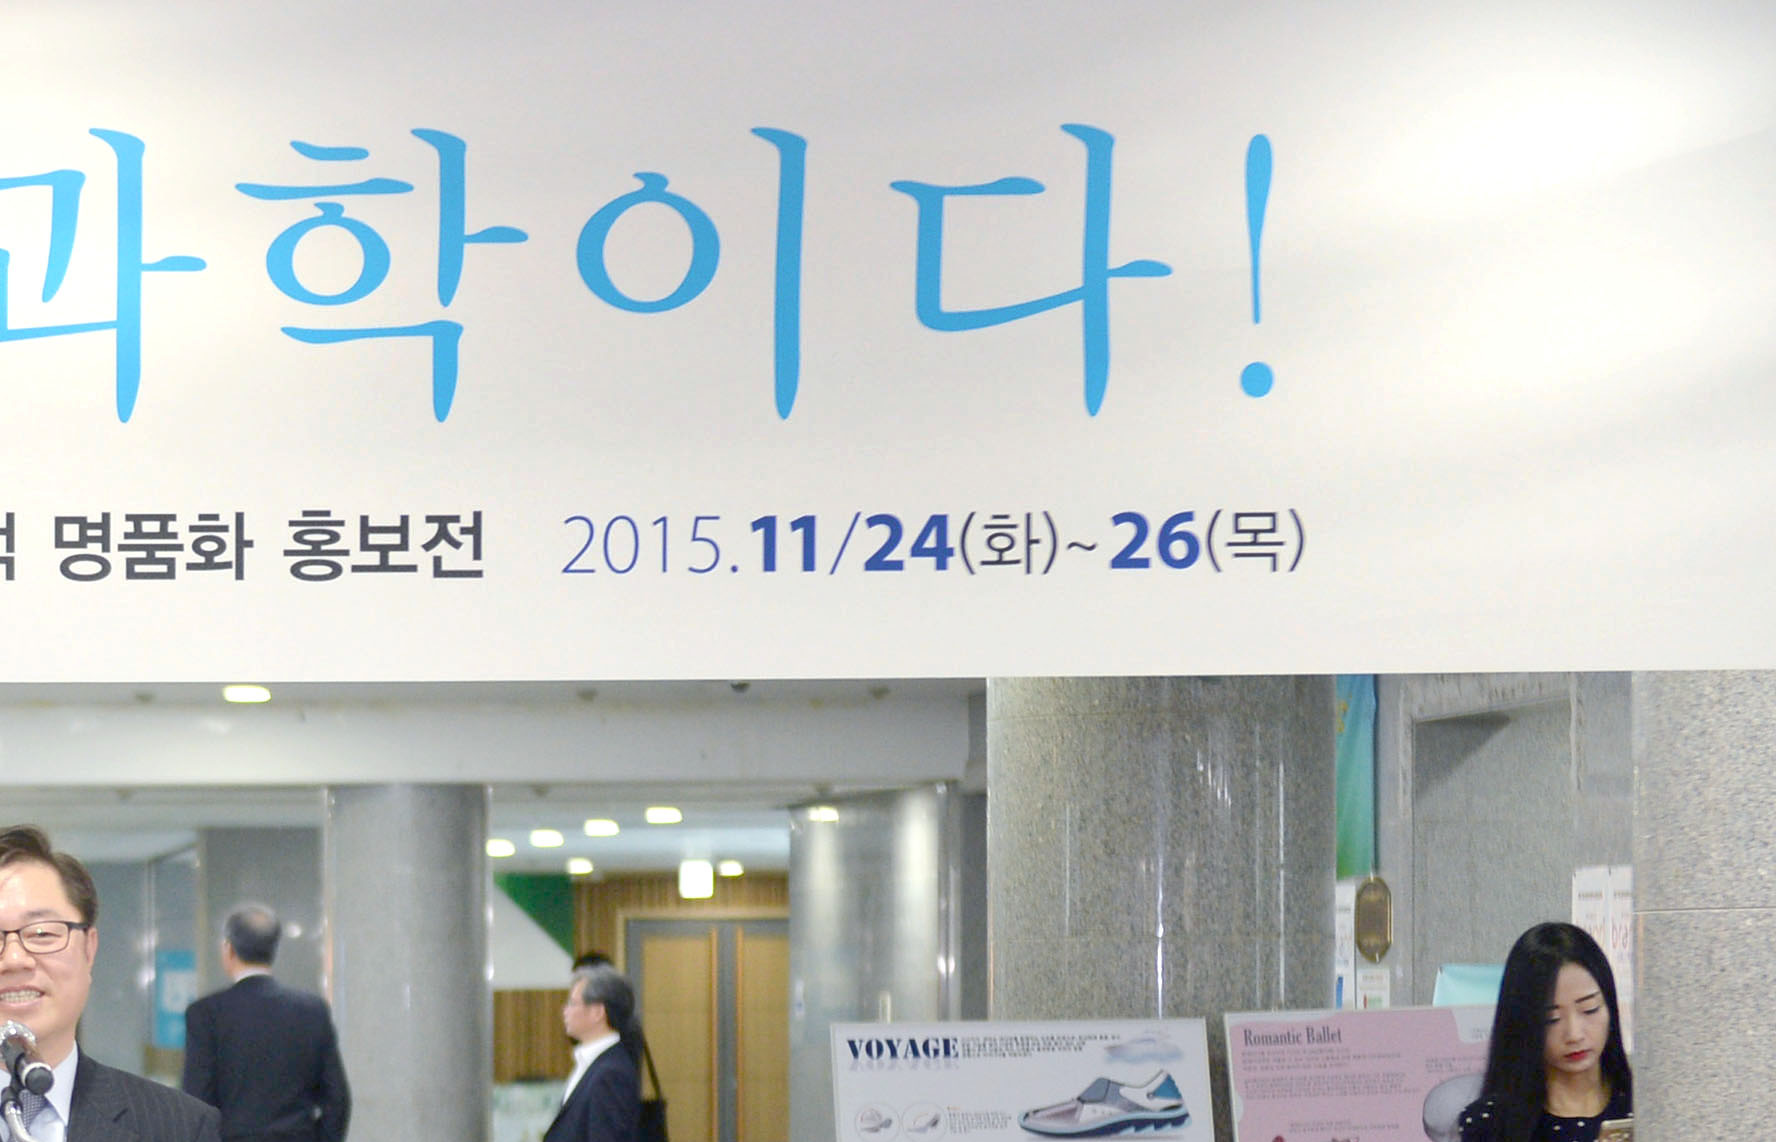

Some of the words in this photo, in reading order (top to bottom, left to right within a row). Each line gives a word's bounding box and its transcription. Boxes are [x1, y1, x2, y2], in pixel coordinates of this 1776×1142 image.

[54, 511, 255, 582] 명품화
[283, 510, 484, 582] 홍보전
[561, 508, 1307, 577] 2015.11/24(화)~26(목)
[1243, 1027, 1303, 1047] Romantic
[1305, 1025, 1342, 1044] Ballet
[847, 1037, 959, 1060] VOYAGE
